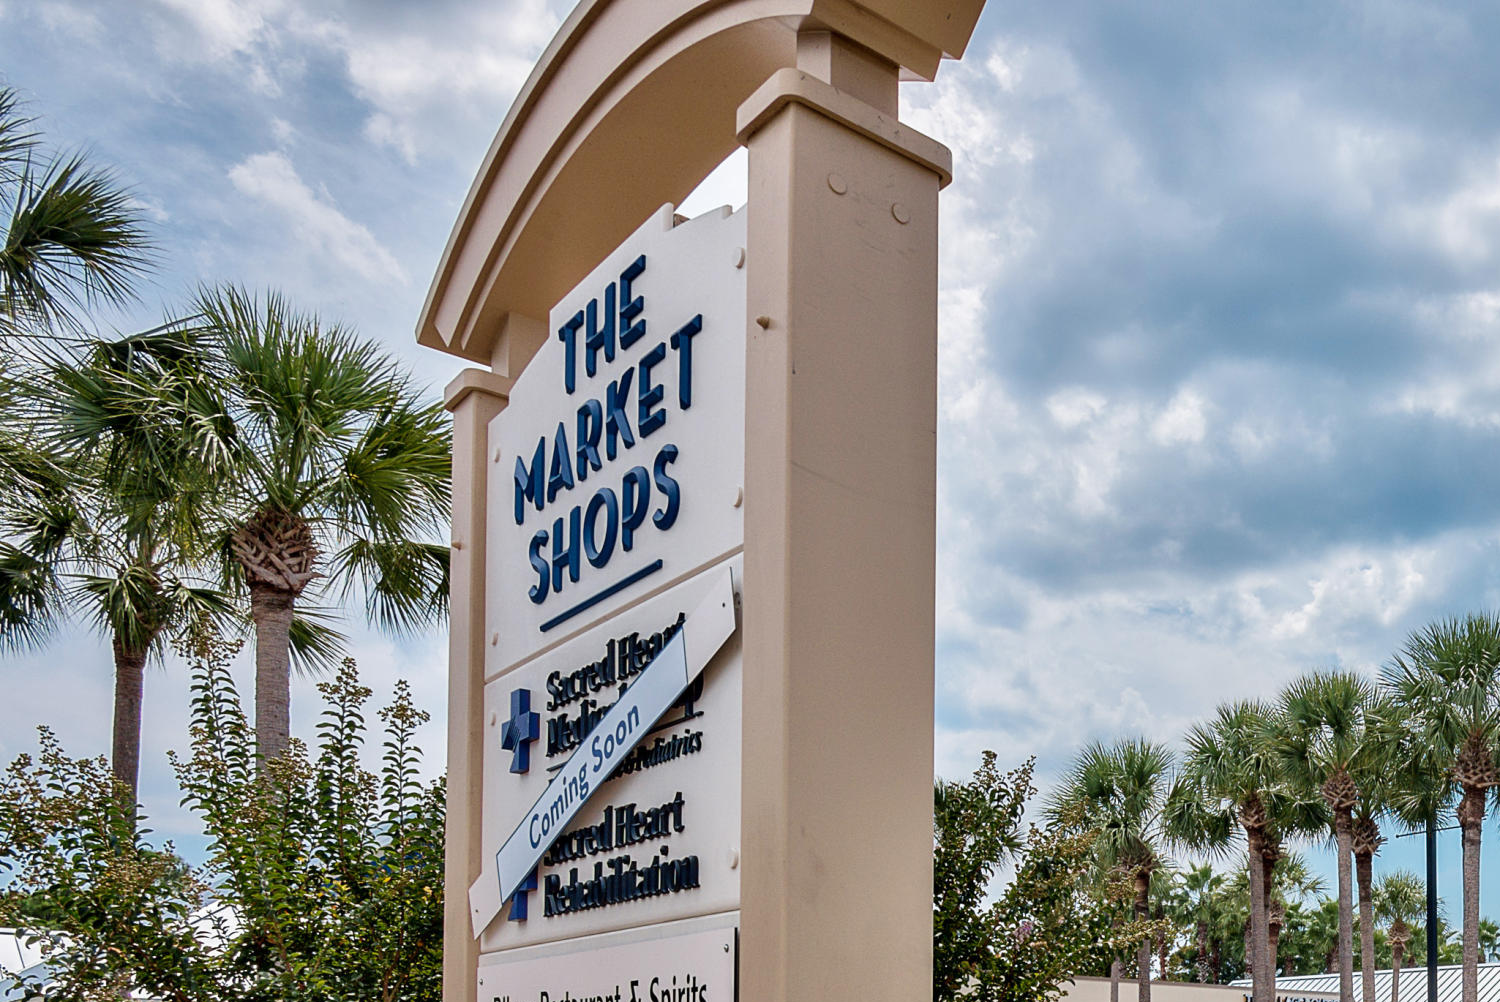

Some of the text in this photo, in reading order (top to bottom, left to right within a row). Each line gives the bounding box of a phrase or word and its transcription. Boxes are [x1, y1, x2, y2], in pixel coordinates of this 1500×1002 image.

[558, 254, 647, 395] THE
[514, 313, 703, 525] MARKET
[528, 443, 680, 604] SHOPS
[546, 638, 617, 711] Sacred
[529, 705, 640, 849] Coming Soon
[544, 791, 686, 866] acred Heart
[544, 845, 700, 917] Rehabilitation
